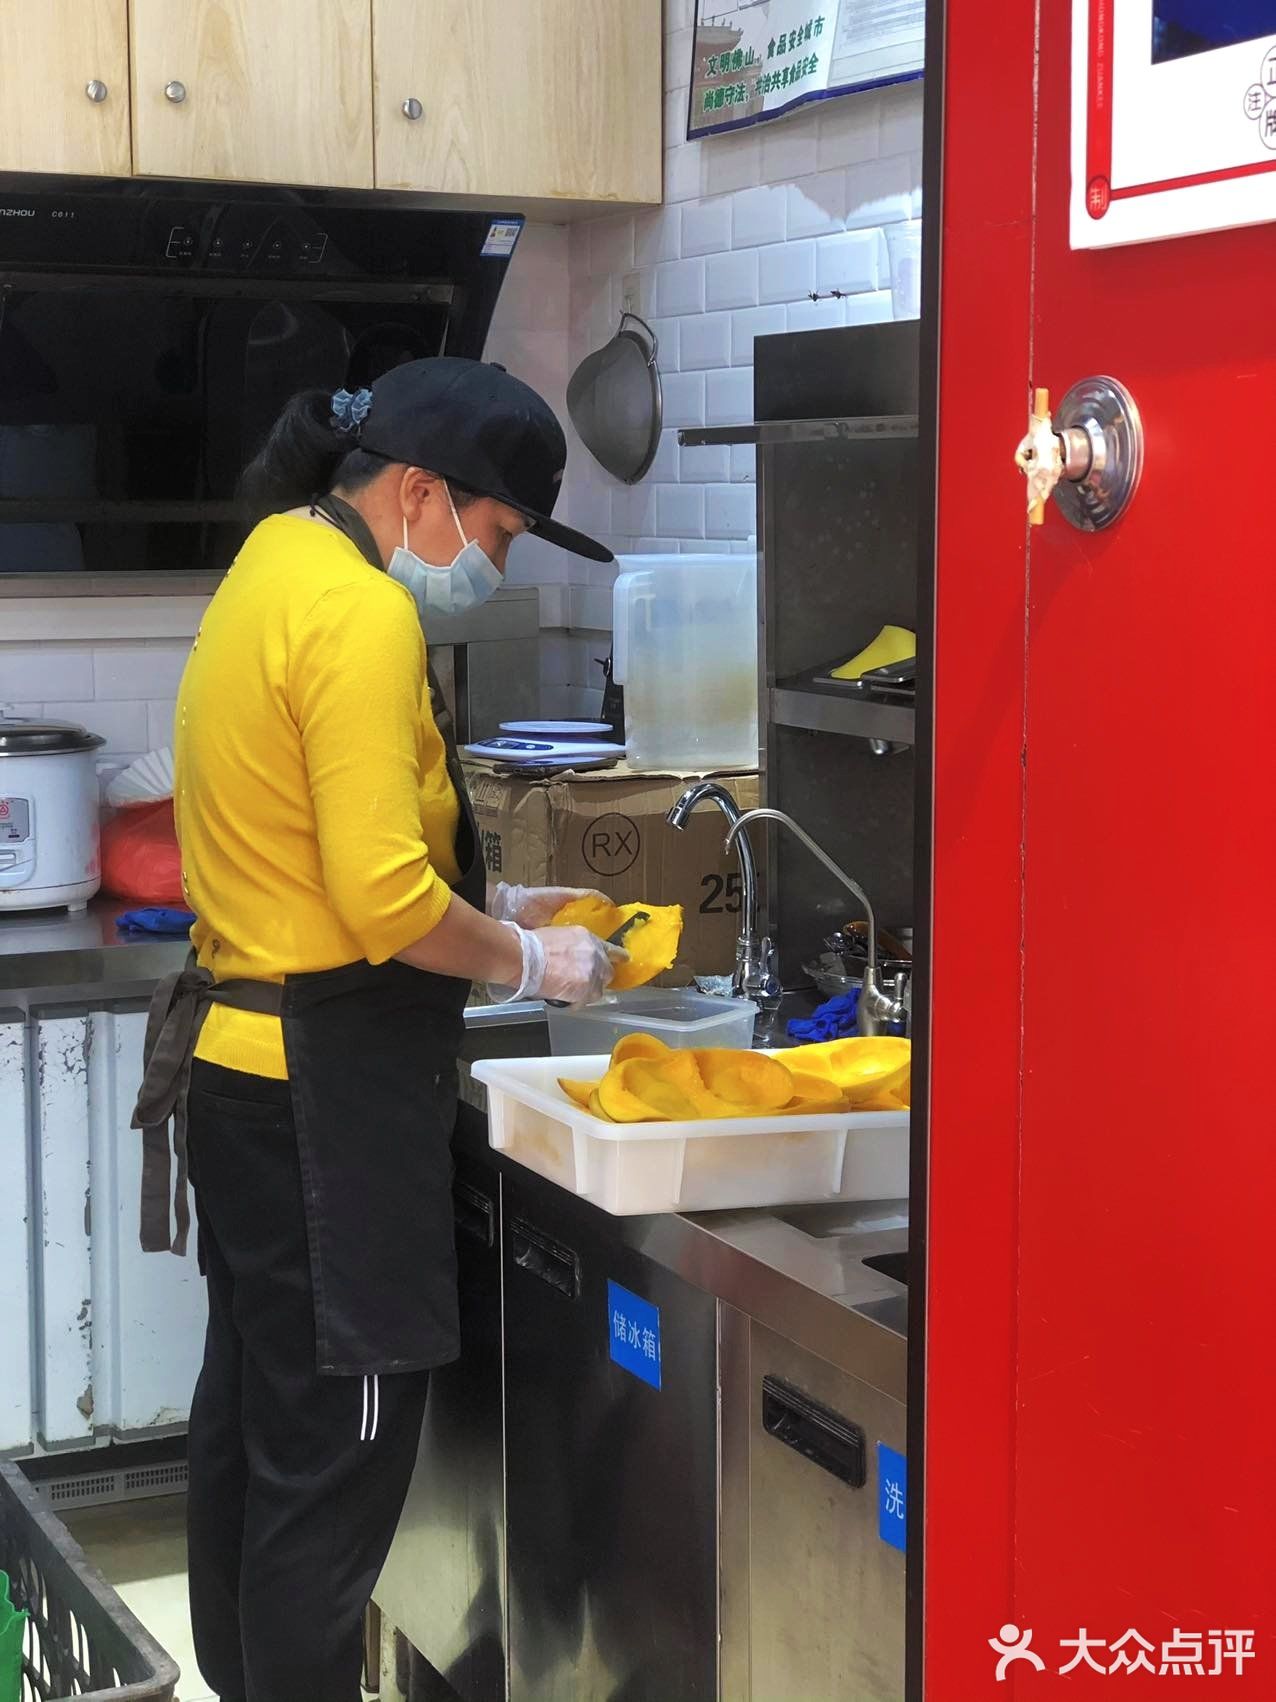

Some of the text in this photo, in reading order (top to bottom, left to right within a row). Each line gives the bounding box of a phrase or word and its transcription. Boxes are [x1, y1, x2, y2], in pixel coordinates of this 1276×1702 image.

[592, 830, 633, 858] RX
[613, 1309, 656, 1361] 储冰箱
[885, 1479, 904, 1520] 洗
